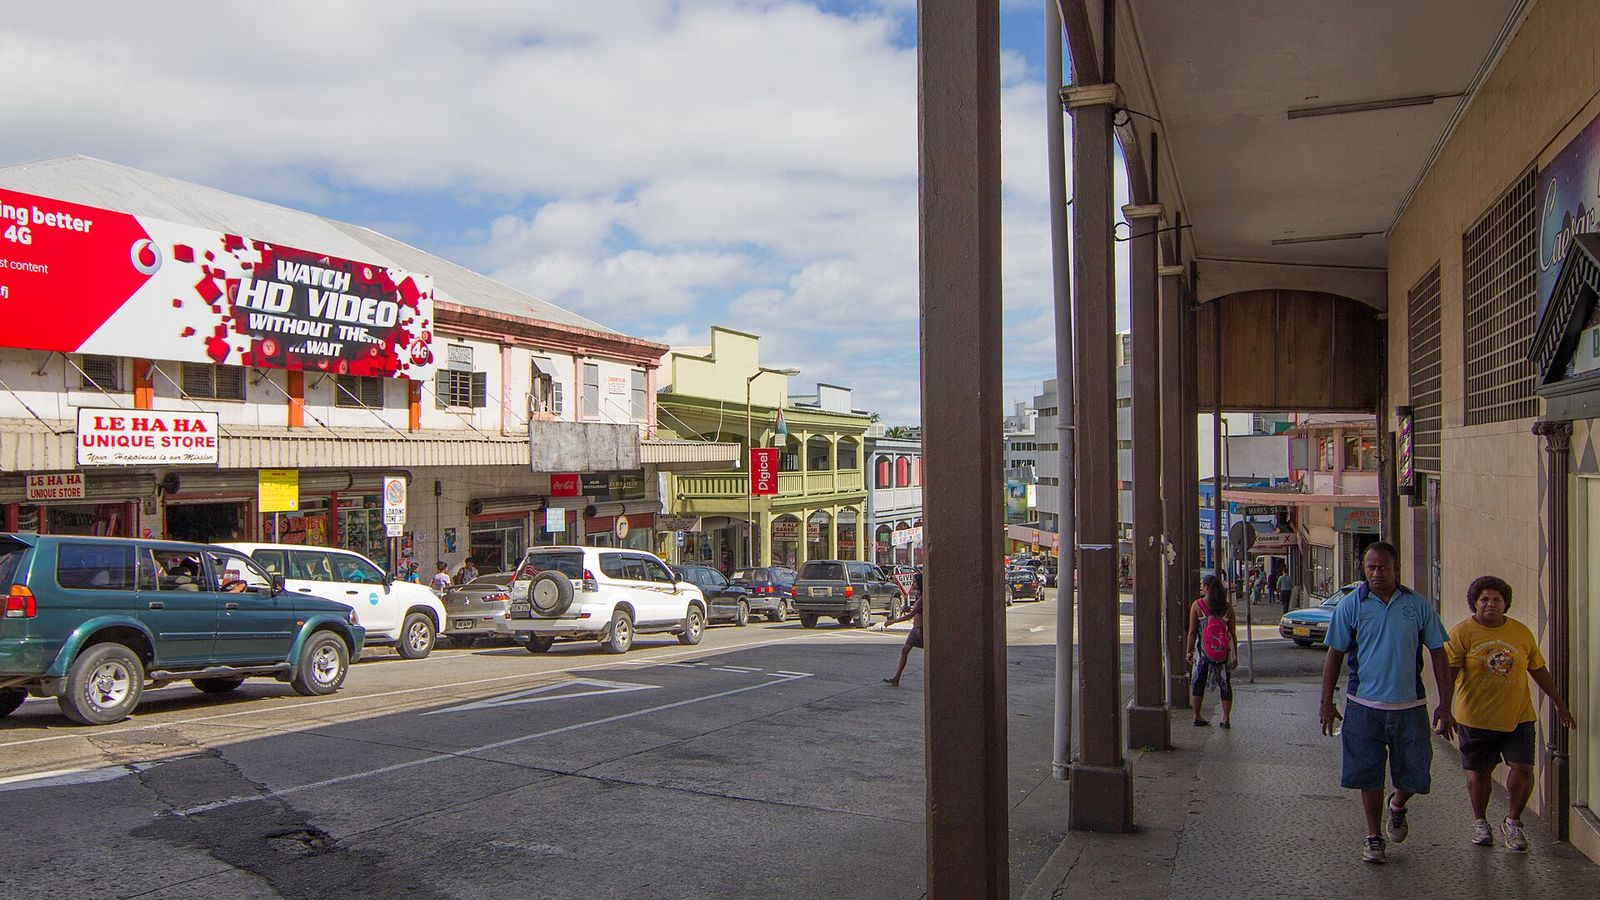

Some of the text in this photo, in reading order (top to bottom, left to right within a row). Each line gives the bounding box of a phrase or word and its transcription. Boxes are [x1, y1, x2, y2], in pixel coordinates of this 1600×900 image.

[32, 206, 93, 233] better
[4, 225, 32, 245] 4G
[10, 261, 49, 274] content
[276, 260, 351, 291] WATCH
[235, 278, 399, 328] HD VIDEO
[249, 313, 332, 337] WITHOUT
[288, 341, 344, 356] ...WAIT
[411, 342, 427, 358] 4G
[93, 416, 208, 433] LE HA HA
[82, 434, 215, 448] UNIQUE STORE
[87, 452, 108, 463] Your
[114, 452, 158, 463] Happiness
[183, 453, 214, 462] Mission
[758, 452, 771, 491] Digicel
[30, 474, 82, 487] LE HA HA
[30, 487, 81, 499] UNIQUE STORE
[898, 574, 914, 582] GIVE
